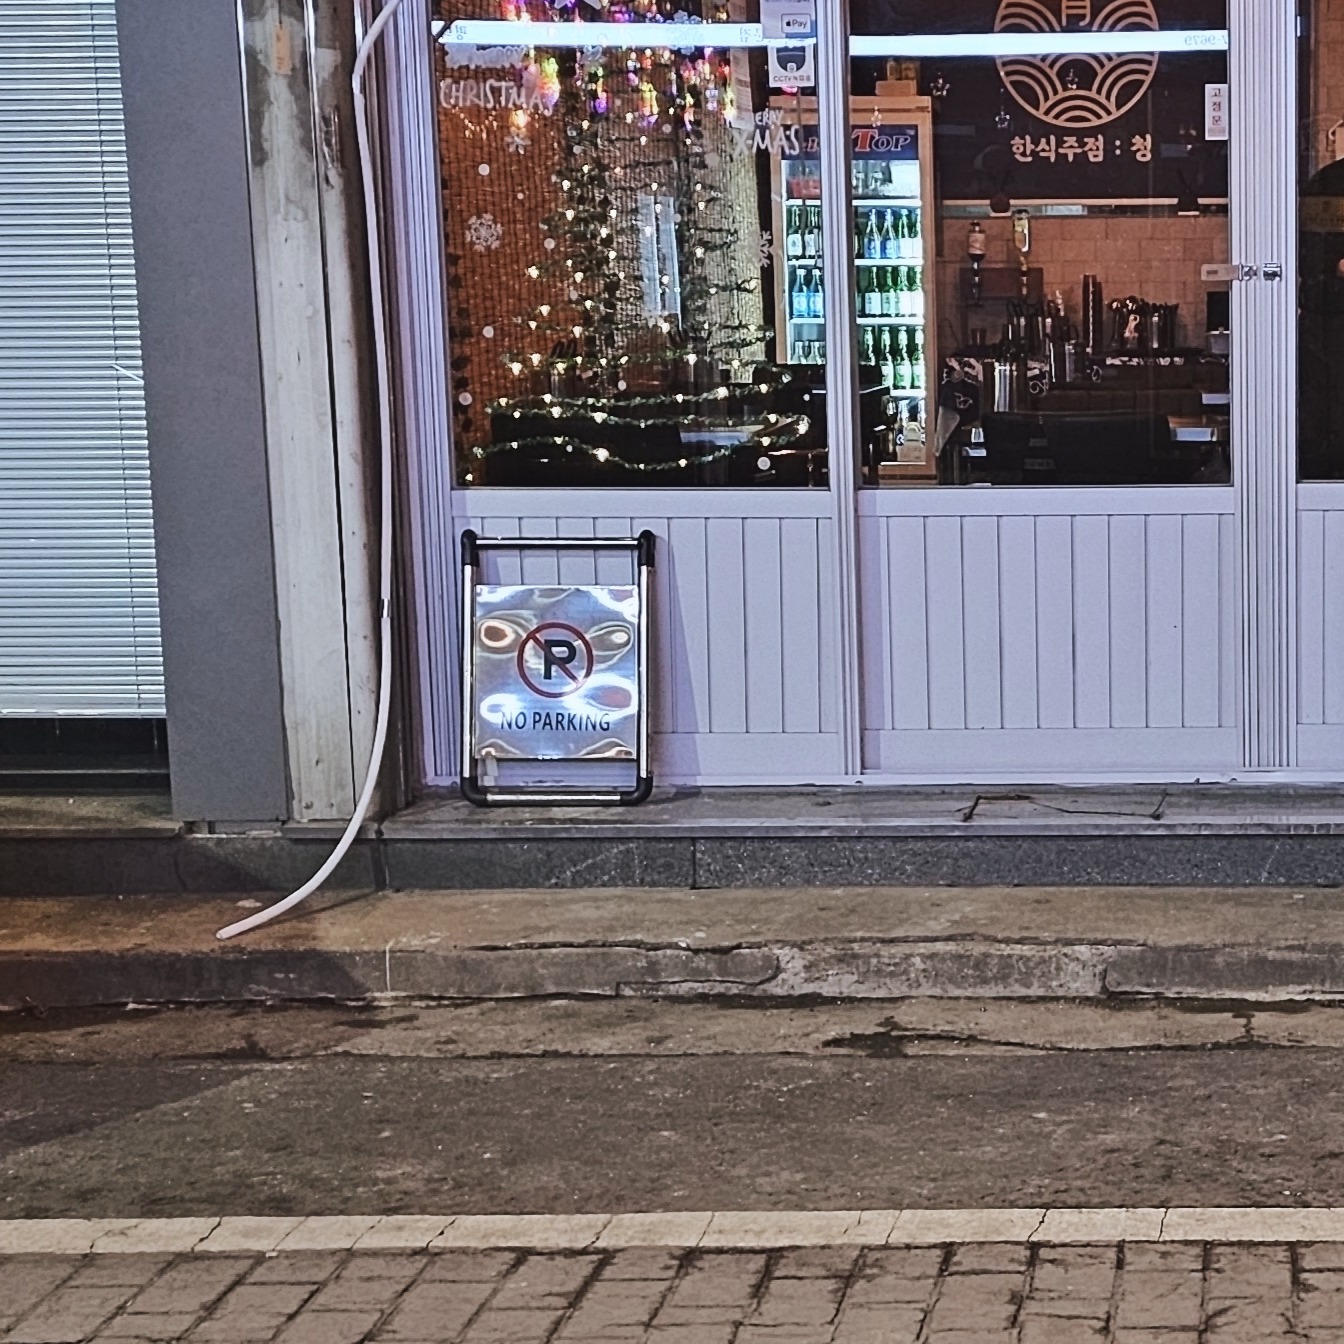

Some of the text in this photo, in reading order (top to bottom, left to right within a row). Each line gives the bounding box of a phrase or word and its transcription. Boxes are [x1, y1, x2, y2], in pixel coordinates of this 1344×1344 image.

[1010, 134, 1104, 163] 한식주점
[1130, 134, 1152, 162] 청
[501, 711, 610, 731] NO PARKING
